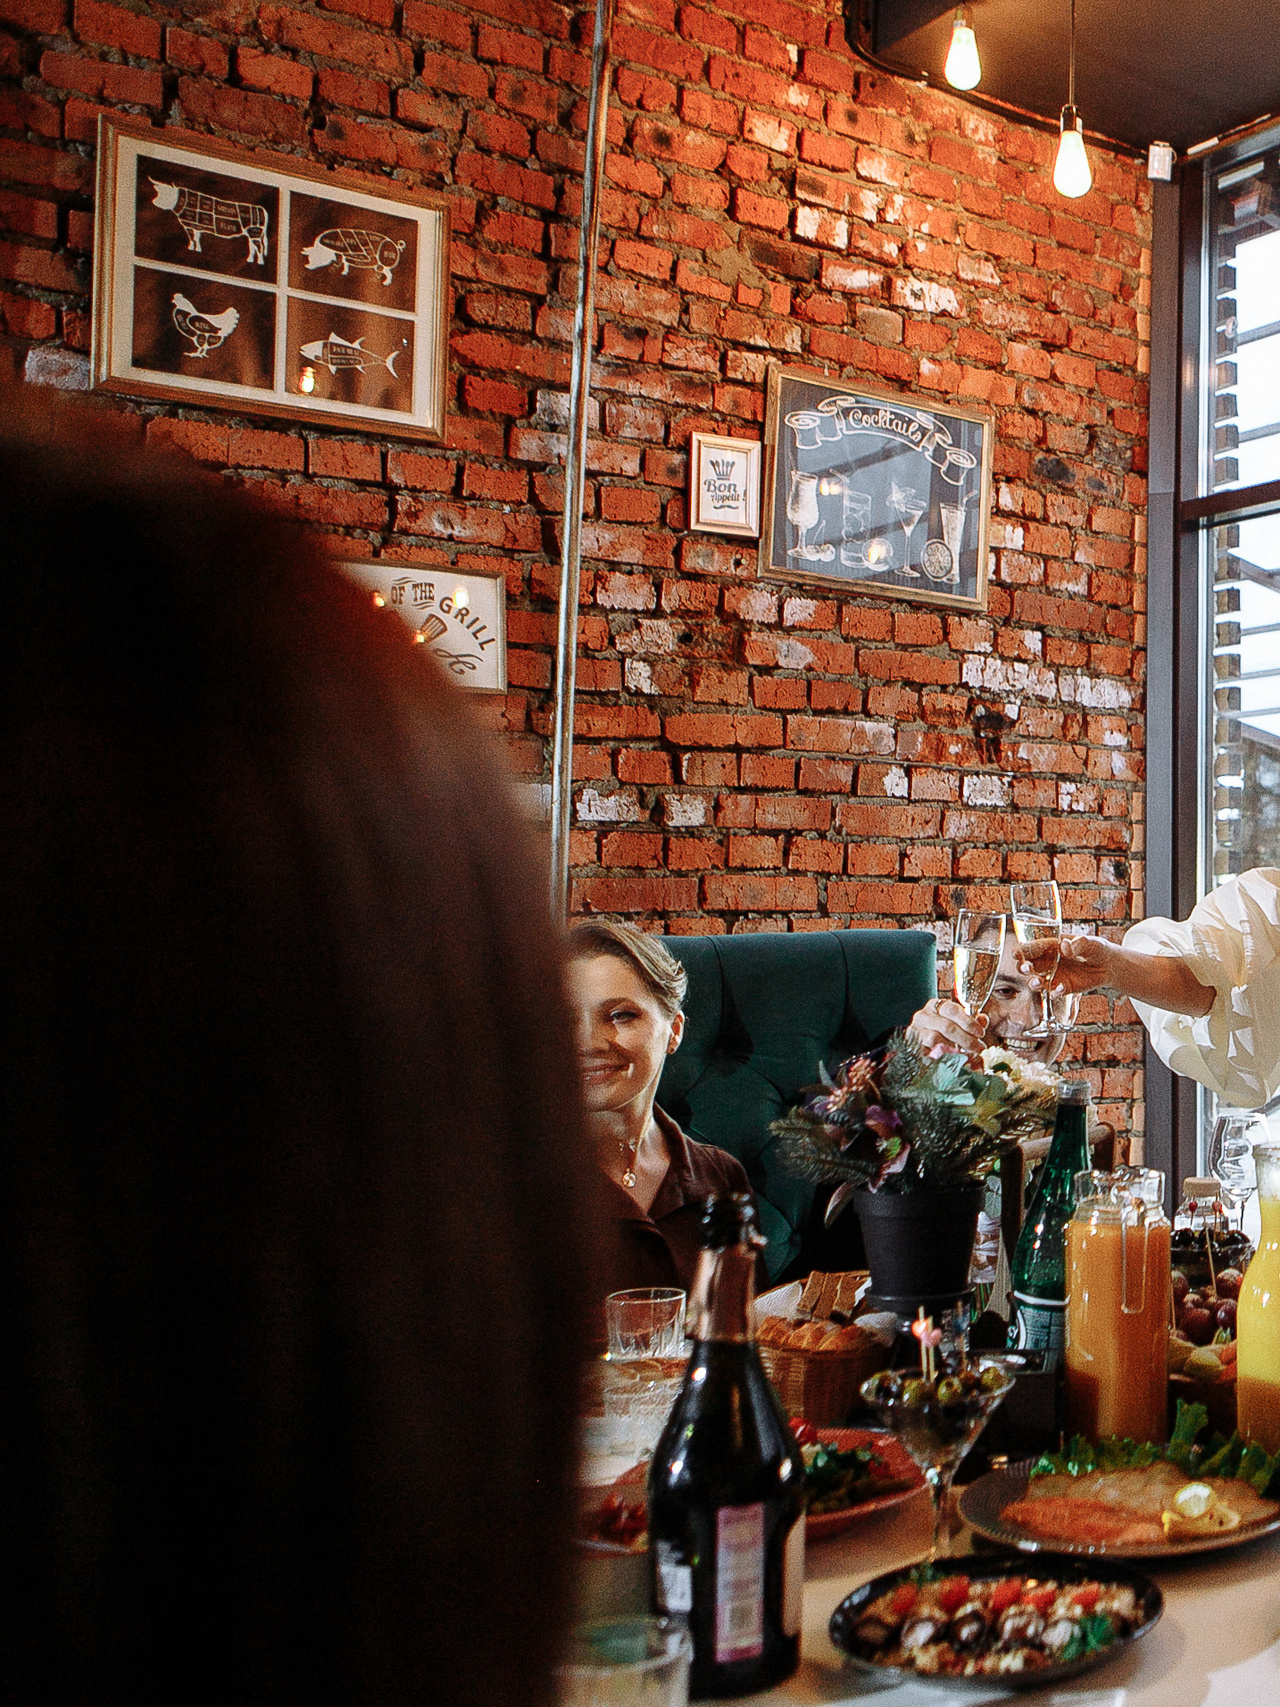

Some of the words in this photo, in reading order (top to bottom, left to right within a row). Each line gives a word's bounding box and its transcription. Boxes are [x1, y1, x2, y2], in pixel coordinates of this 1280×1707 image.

[849, 408, 922, 442] Cocktails
[703, 478, 738, 493] Bon
[390, 585, 406, 605] OF
[412, 582, 436, 602] THE
[438, 596, 496, 651] GRILL
